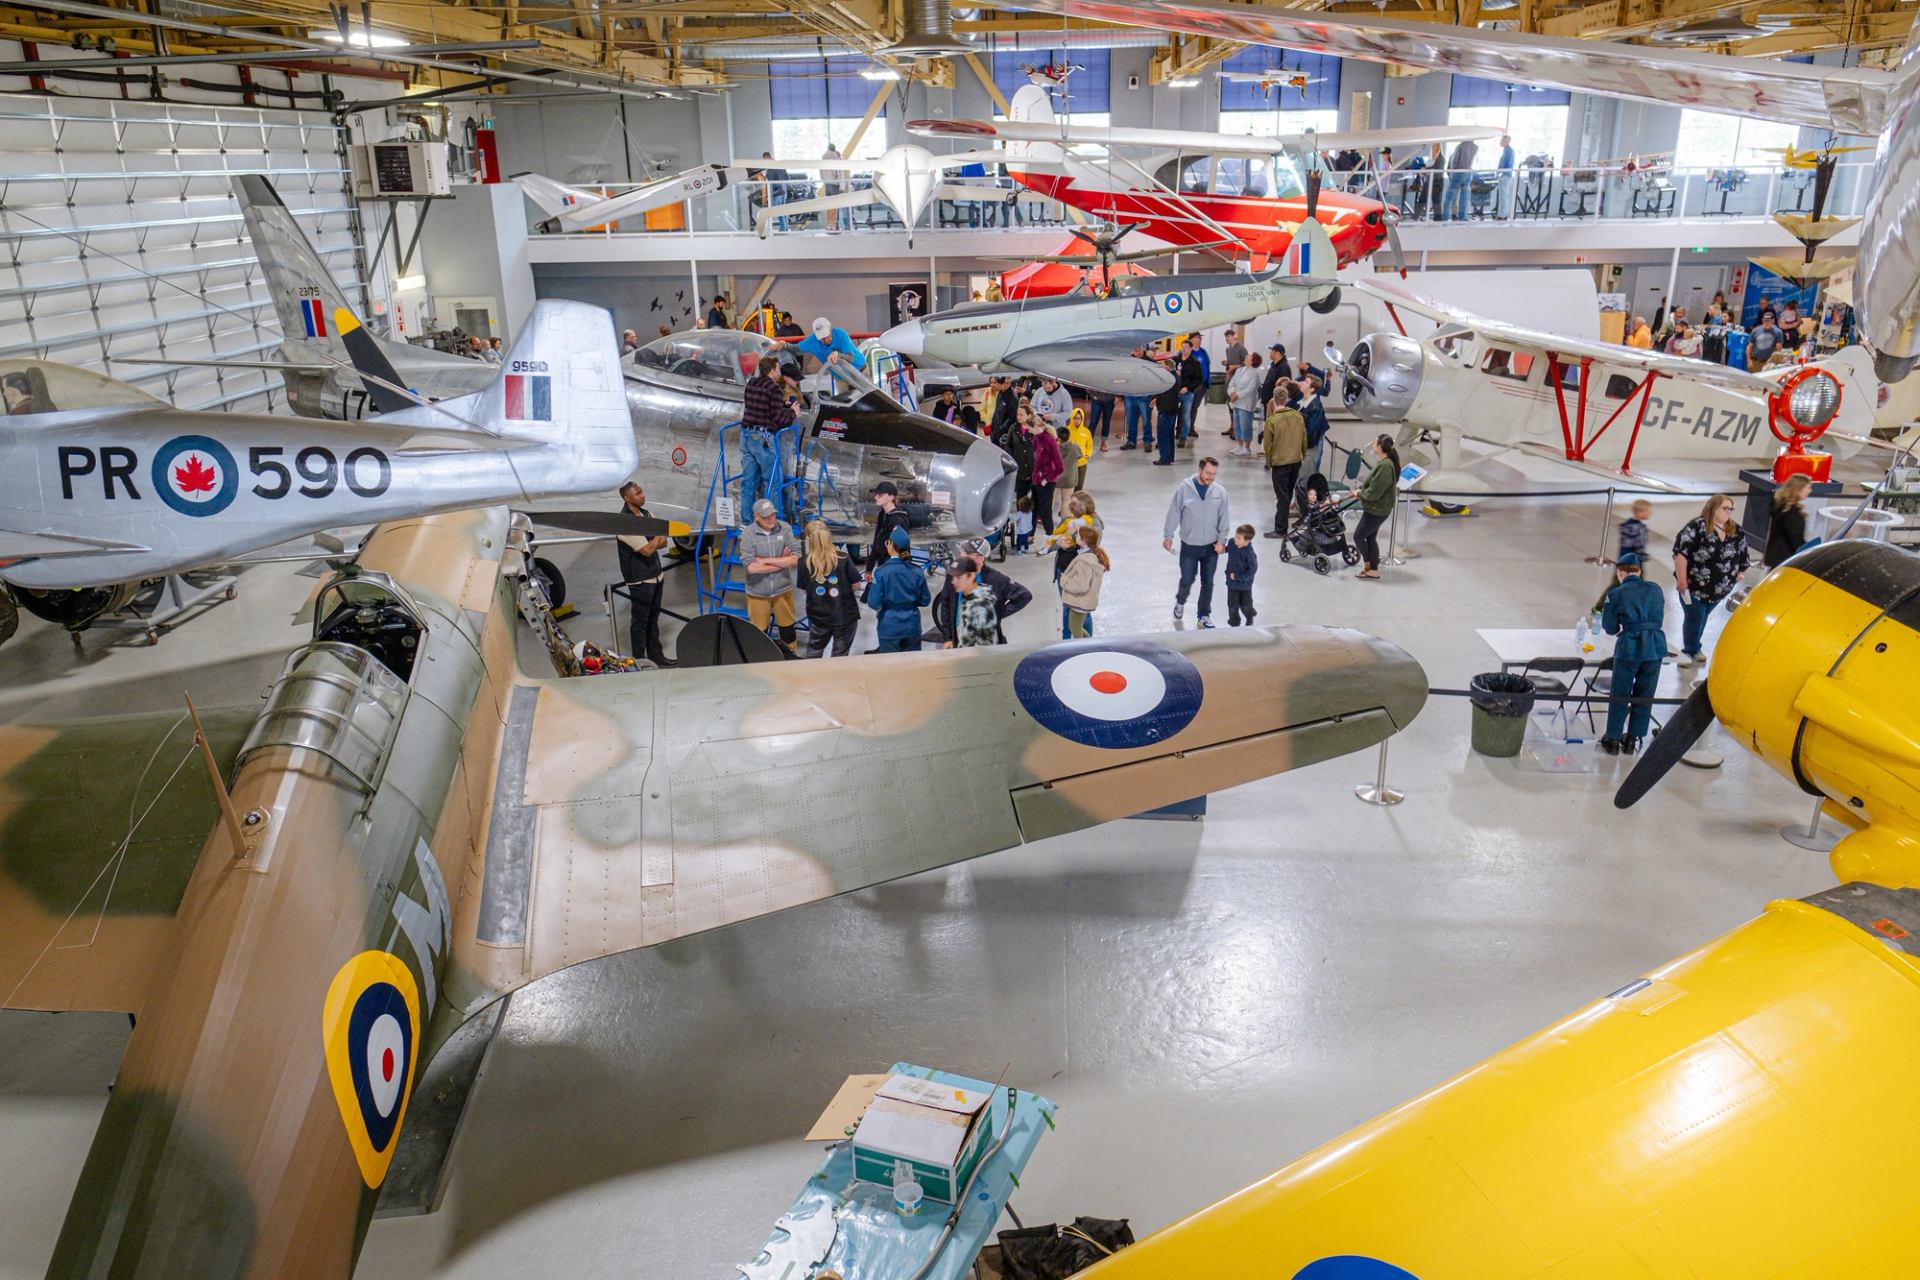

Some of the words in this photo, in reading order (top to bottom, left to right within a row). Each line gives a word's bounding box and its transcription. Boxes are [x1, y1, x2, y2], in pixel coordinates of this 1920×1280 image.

[1132, 295, 1161, 319] AA
[1187, 290, 1204, 313] N
[512, 360, 549, 372] 9590
[1641, 396, 1762, 446] CF-AZM
[58, 446, 142, 499] PR
[248, 446, 392, 500] 590
